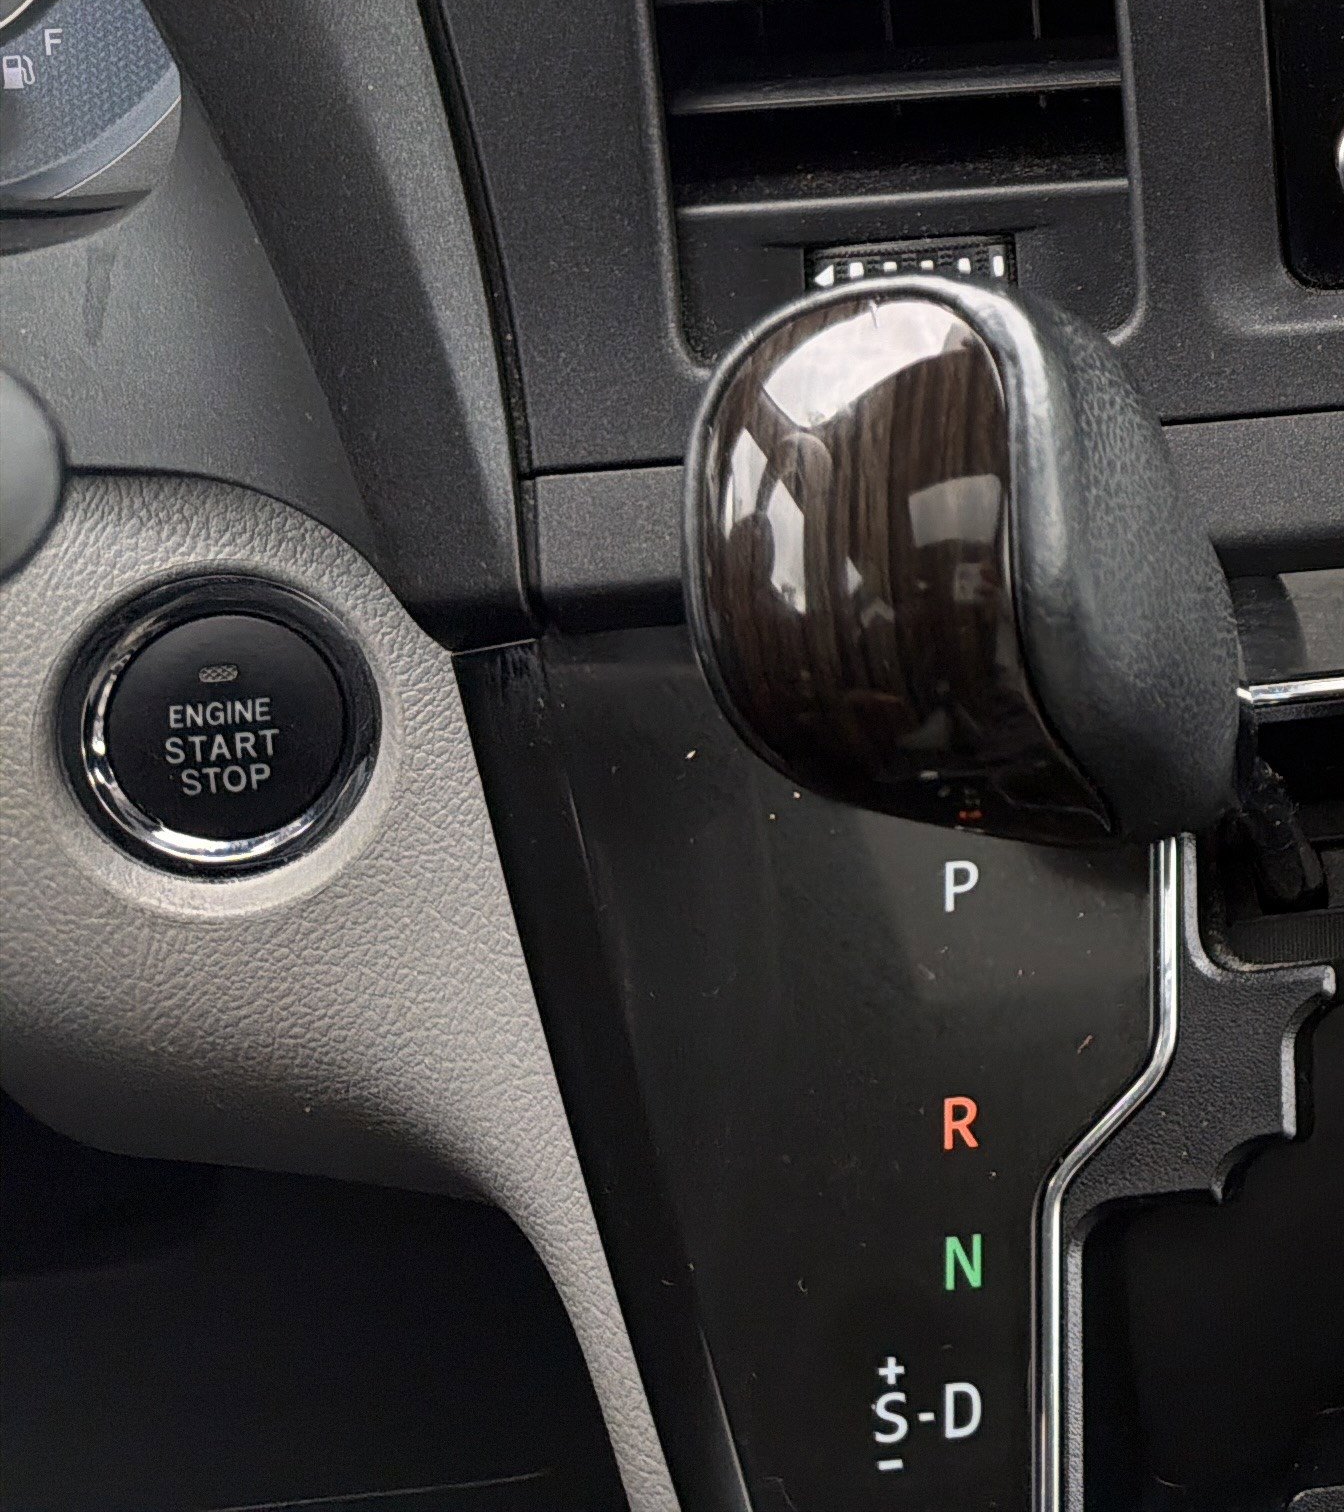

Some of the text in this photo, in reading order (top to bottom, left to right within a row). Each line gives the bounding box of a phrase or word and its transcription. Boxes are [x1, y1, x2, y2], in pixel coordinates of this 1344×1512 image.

[44, 28, 63, 56] F
[169, 697, 271, 728] ENGINE
[165, 729, 279, 763] START
[182, 763, 271, 795] STOP
[945, 860, 979, 913] P
[943, 1096, 979, 1151] R
[945, 1233, 983, 1291] N
